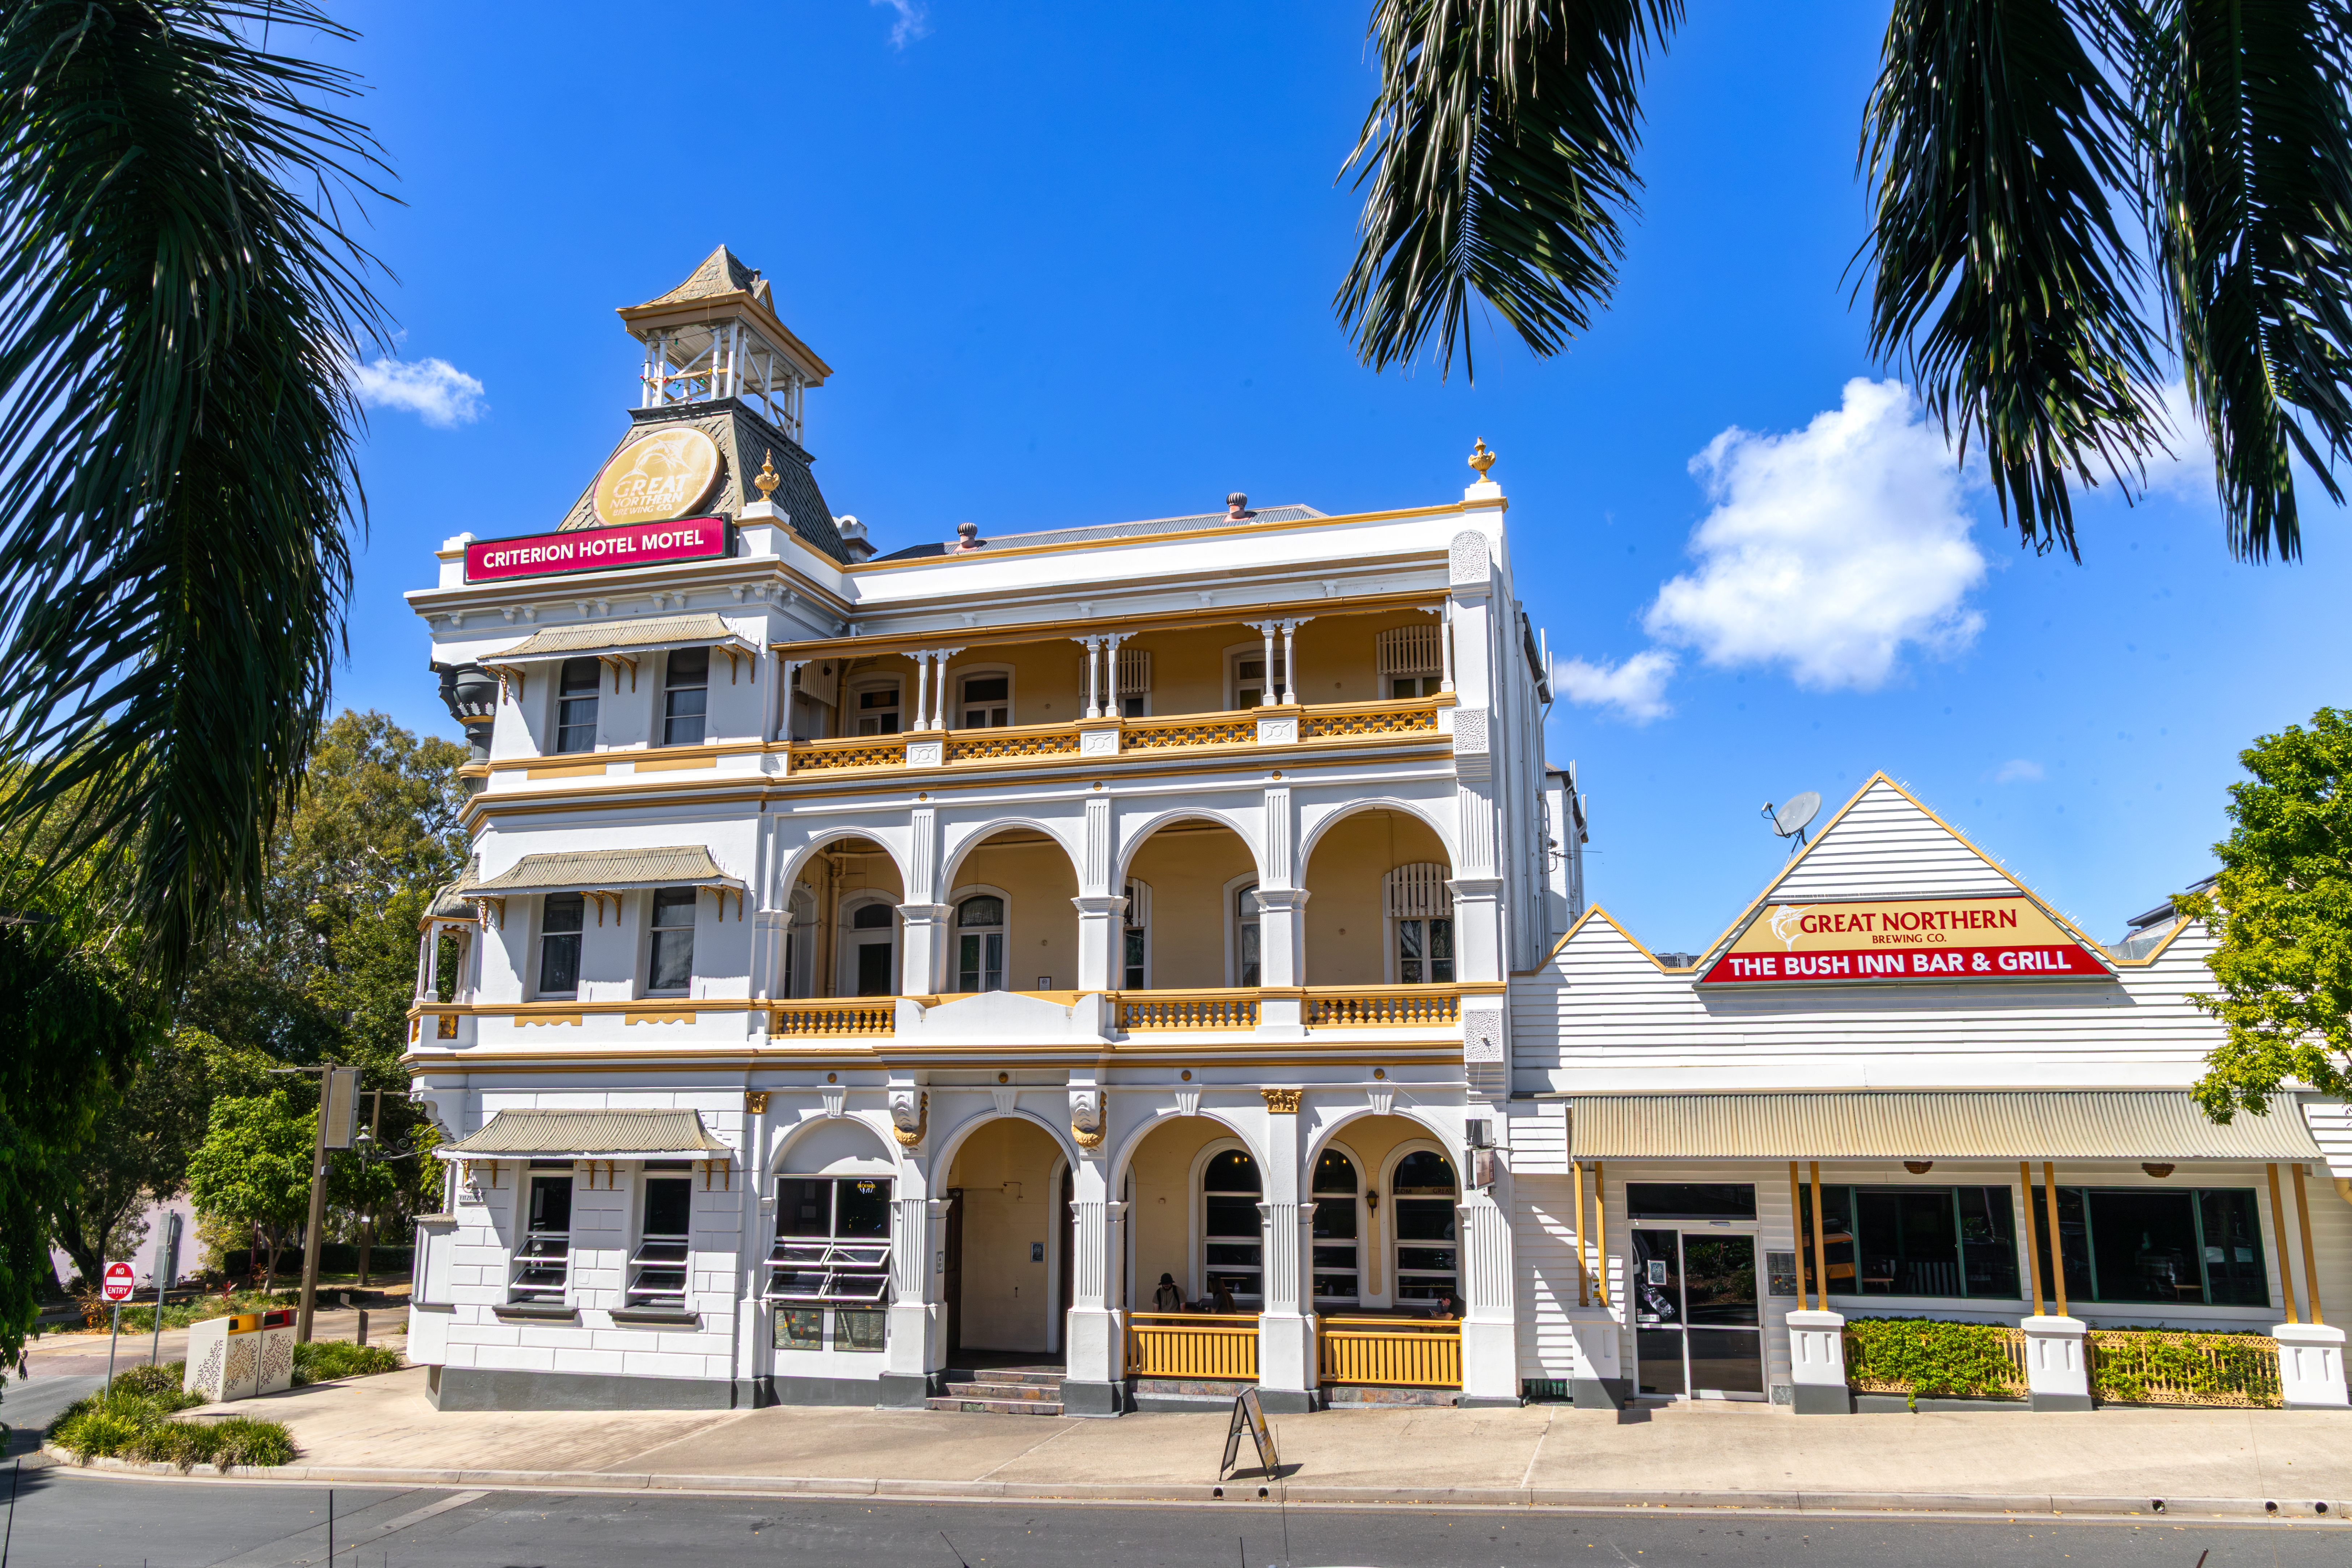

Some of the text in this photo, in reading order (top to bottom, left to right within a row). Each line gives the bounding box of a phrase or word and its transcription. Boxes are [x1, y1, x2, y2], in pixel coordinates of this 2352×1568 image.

[613, 473, 693, 498] GREAT
[609, 491, 684, 509] NORTHERN
[612, 505, 654, 516] BREWING
[483, 529, 704, 568] CRITERION HOTEL MOTEL
[1799, 909, 2017, 933] GREAT NORTHERN
[1872, 933, 1947, 944] BREWING CO.
[1729, 951, 2072, 976] THE BUSH INN BAR & GRILL
